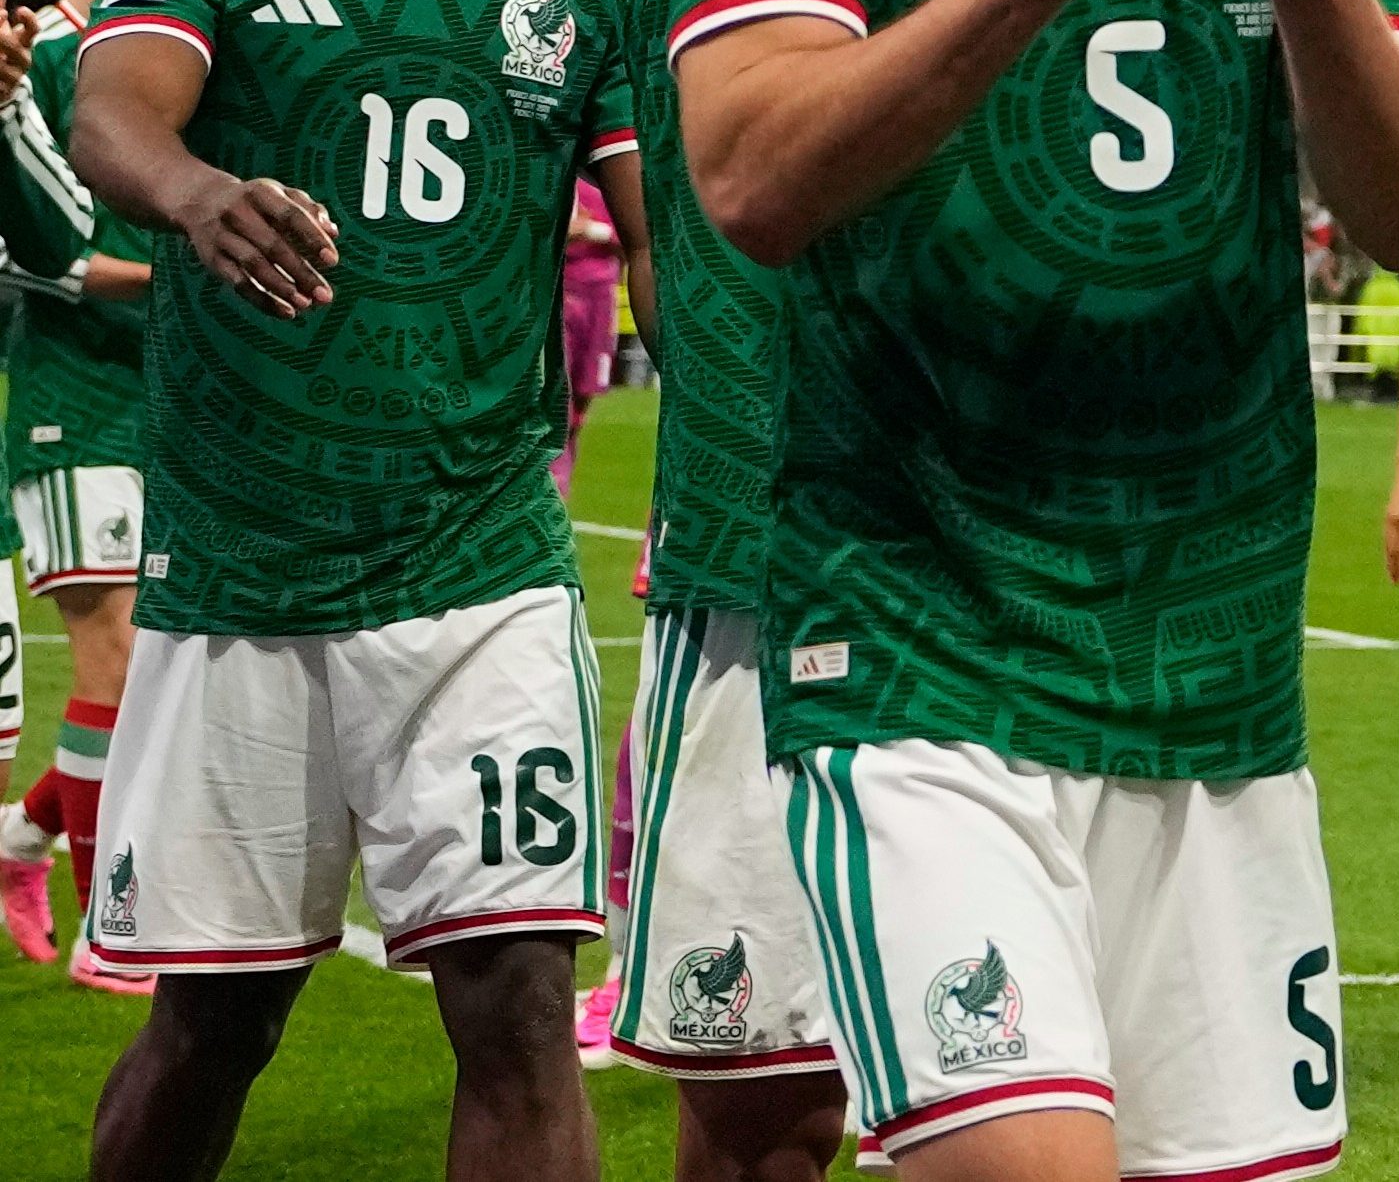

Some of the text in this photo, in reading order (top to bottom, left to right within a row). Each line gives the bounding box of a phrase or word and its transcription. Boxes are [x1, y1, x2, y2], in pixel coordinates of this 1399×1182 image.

[504, 58, 564, 84] MÉXICO
[1085, 20, 1175, 193] 5
[360, 92, 470, 223] 16
[470, 746, 576, 866] 16
[672, 1019, 743, 1039] MÉXICO
[943, 1037, 1024, 1068] MÉXICO
[1286, 945, 1338, 1111] 5
